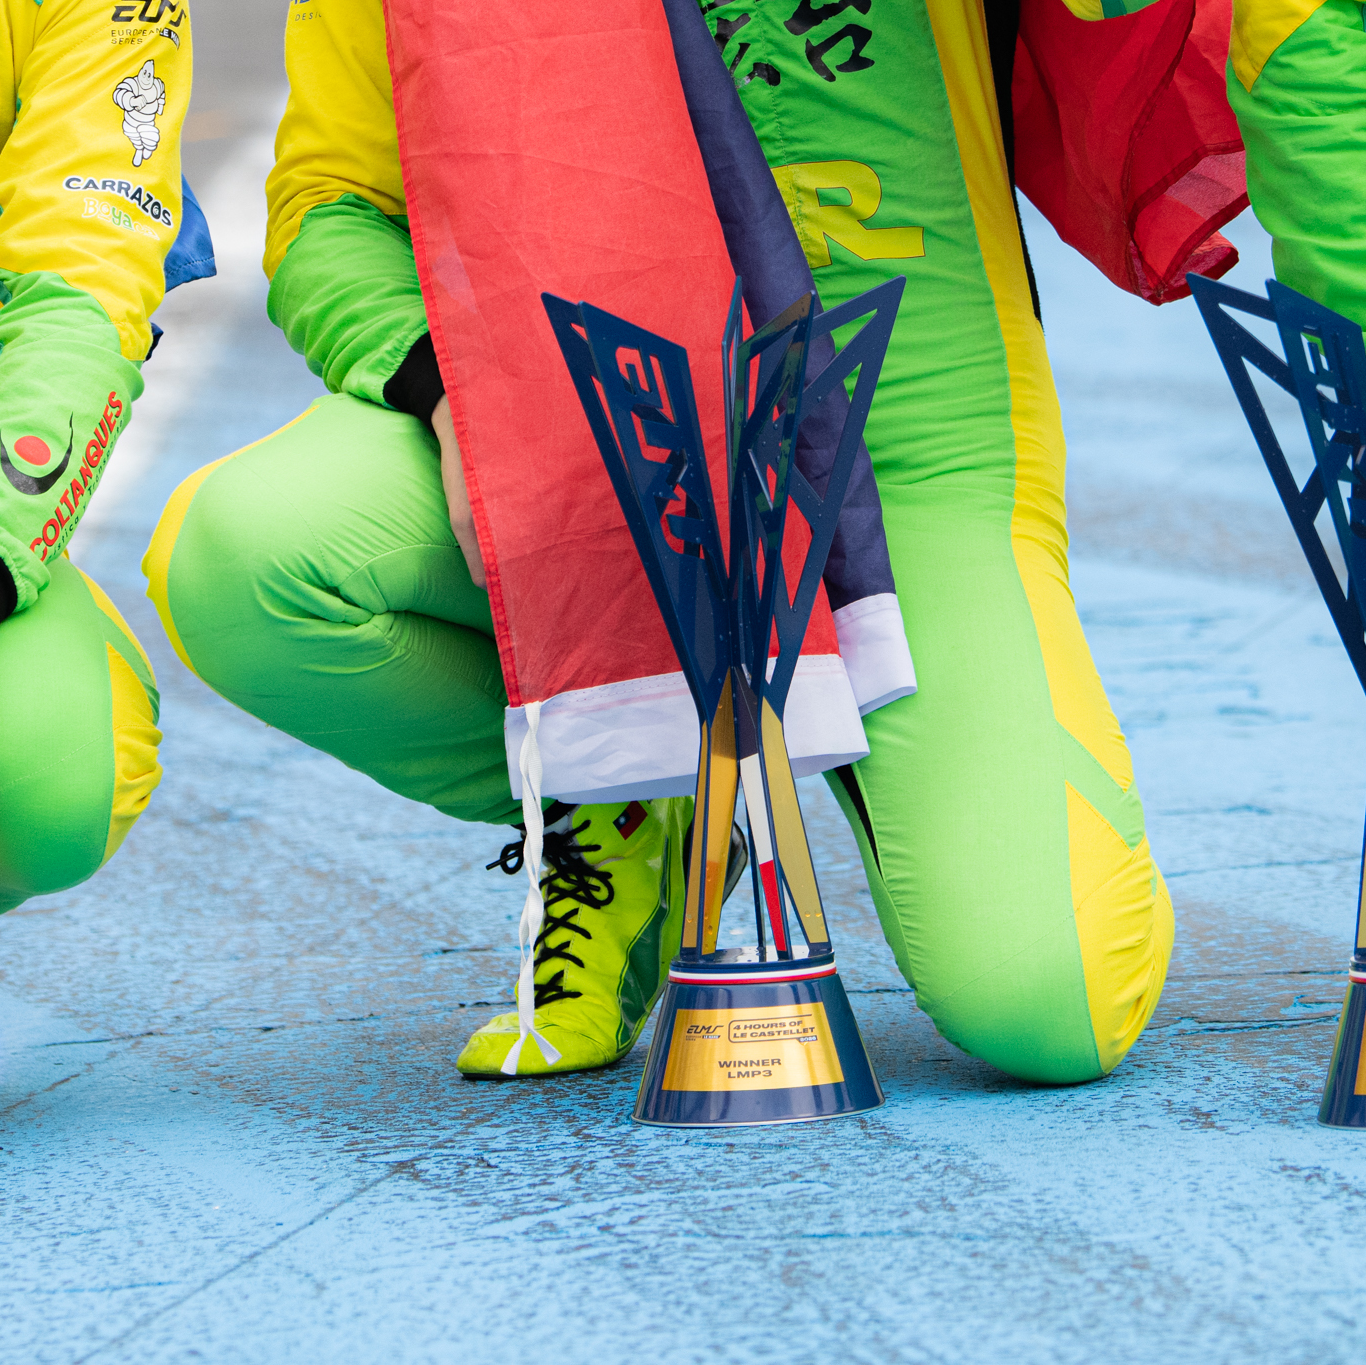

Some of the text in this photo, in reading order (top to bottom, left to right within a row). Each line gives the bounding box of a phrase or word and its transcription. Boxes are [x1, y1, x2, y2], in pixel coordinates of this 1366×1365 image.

[64, 176, 172, 227] CARRAZOS
[30, 390, 123, 562] COLTANQUES
[687, 1025, 724, 1034] ELMS
[744, 1022, 786, 1030] HOURS
[750, 1027, 815, 1037] CASTELLET
[718, 1058, 782, 1068] WINNER
[728, 1070, 772, 1078] LMP3
